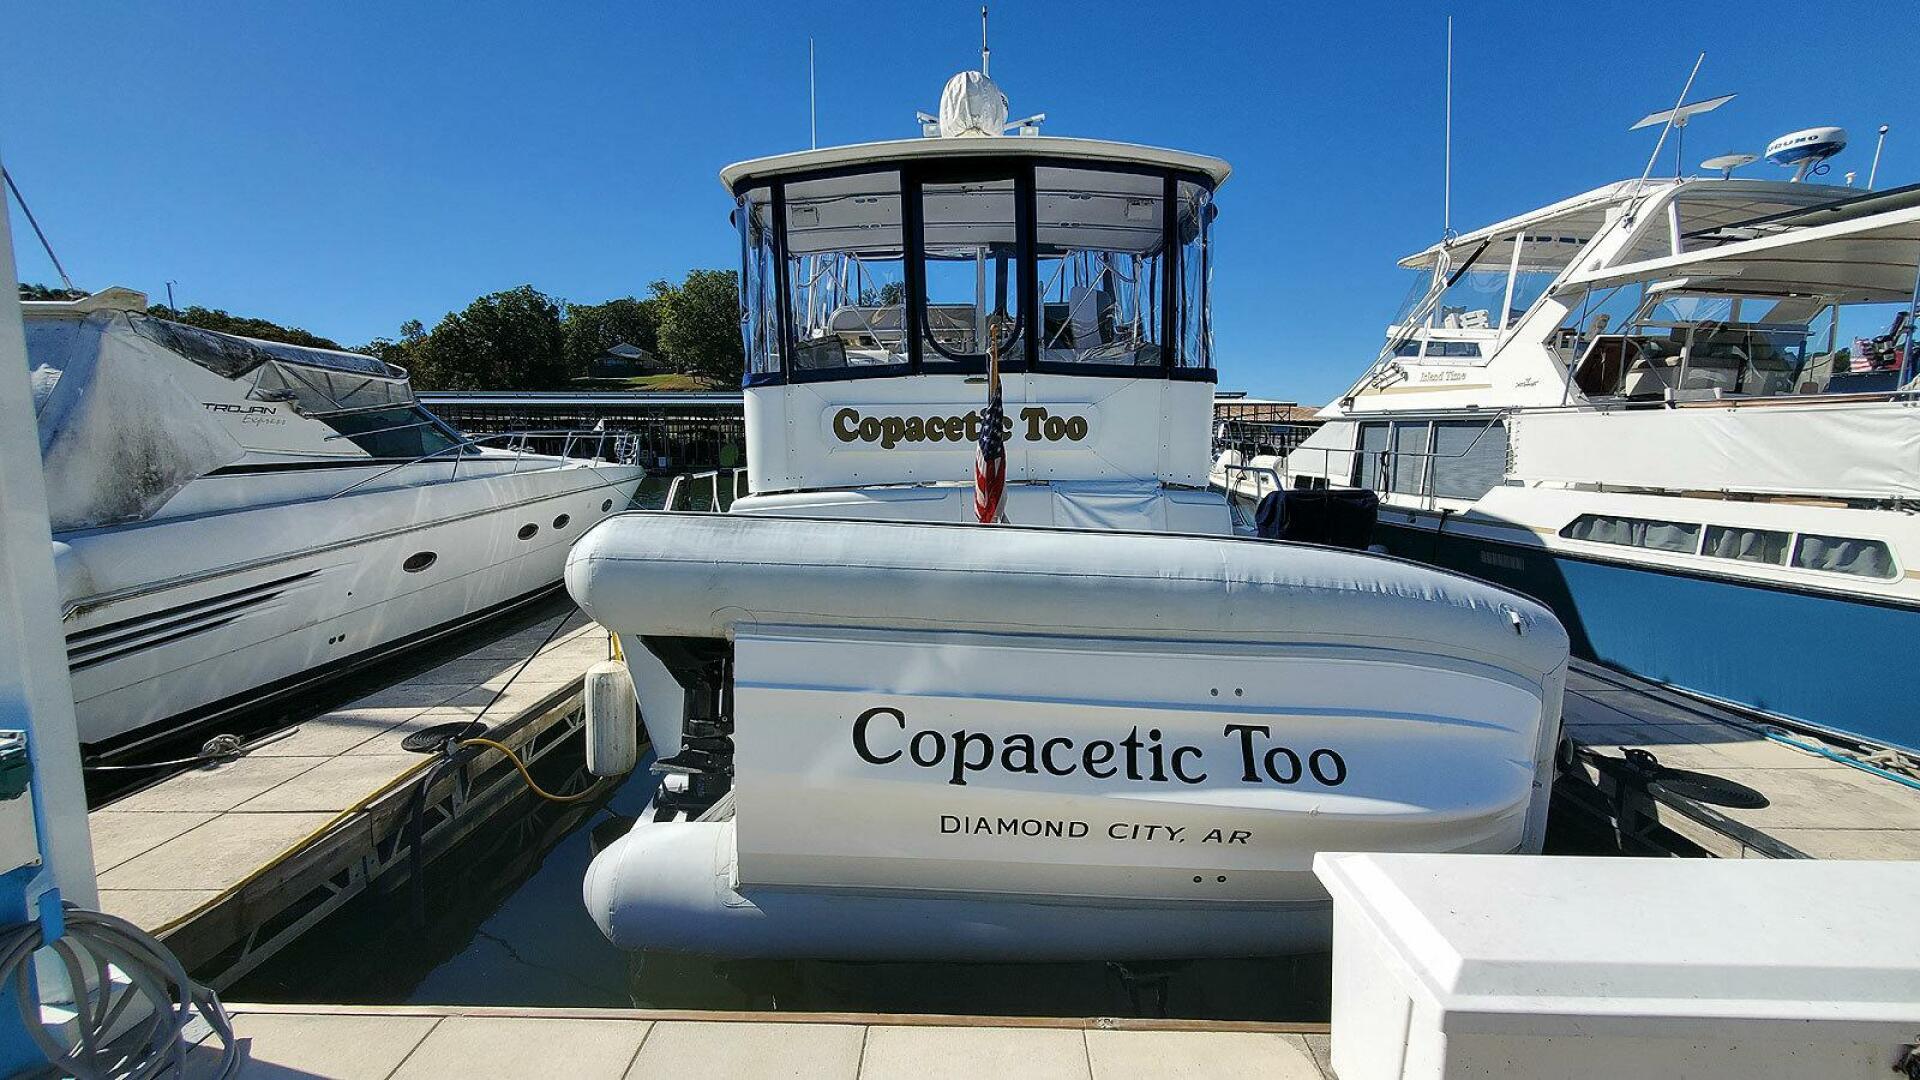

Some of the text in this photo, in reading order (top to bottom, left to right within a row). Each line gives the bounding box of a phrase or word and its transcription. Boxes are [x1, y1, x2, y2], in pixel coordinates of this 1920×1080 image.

[201, 402, 277, 415] TROJAN
[833, 407, 1088, 449] Copacetc Too
[852, 706, 1348, 787] Copacetic Too
[940, 814, 1254, 846] DIAMOND CITY, AR
